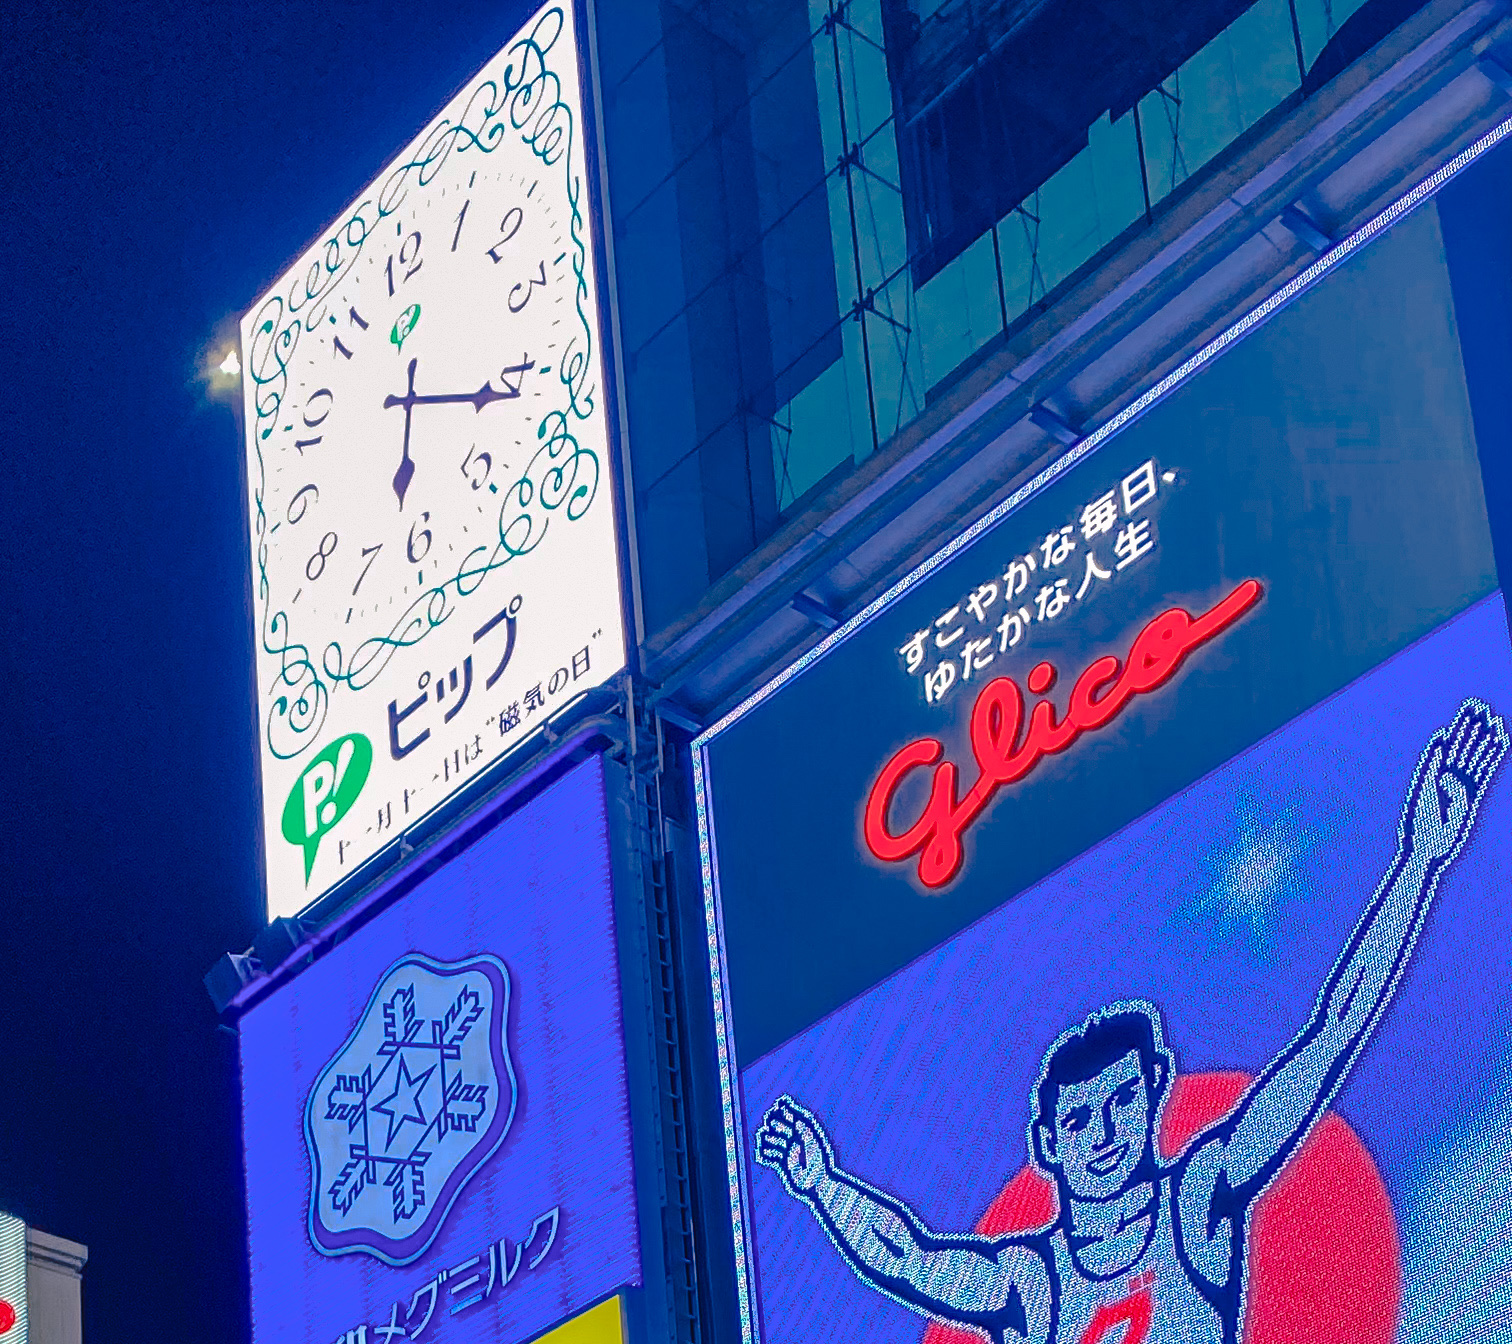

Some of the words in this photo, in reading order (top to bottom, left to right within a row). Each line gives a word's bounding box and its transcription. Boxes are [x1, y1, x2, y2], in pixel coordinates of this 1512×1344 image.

[453, 200, 471, 253] 1
[485, 207, 524, 264] 2
[384, 231, 423, 297] 12
[508, 261, 549, 314] 3
[330, 306, 371, 361] 11
[499, 352, 536, 397] 4
[294, 388, 334, 457] 10
[460, 443, 493, 492] 5
[287, 483, 320, 526] 9
[306, 531, 338, 582] 8
[405, 511, 432, 565] 6
[352, 543, 384, 597] 7
[899, 457, 1178, 675] すこやかな毎日、
[923, 518, 1155, 705] ゆたかな人生
[387, 594, 524, 762] ピップ
